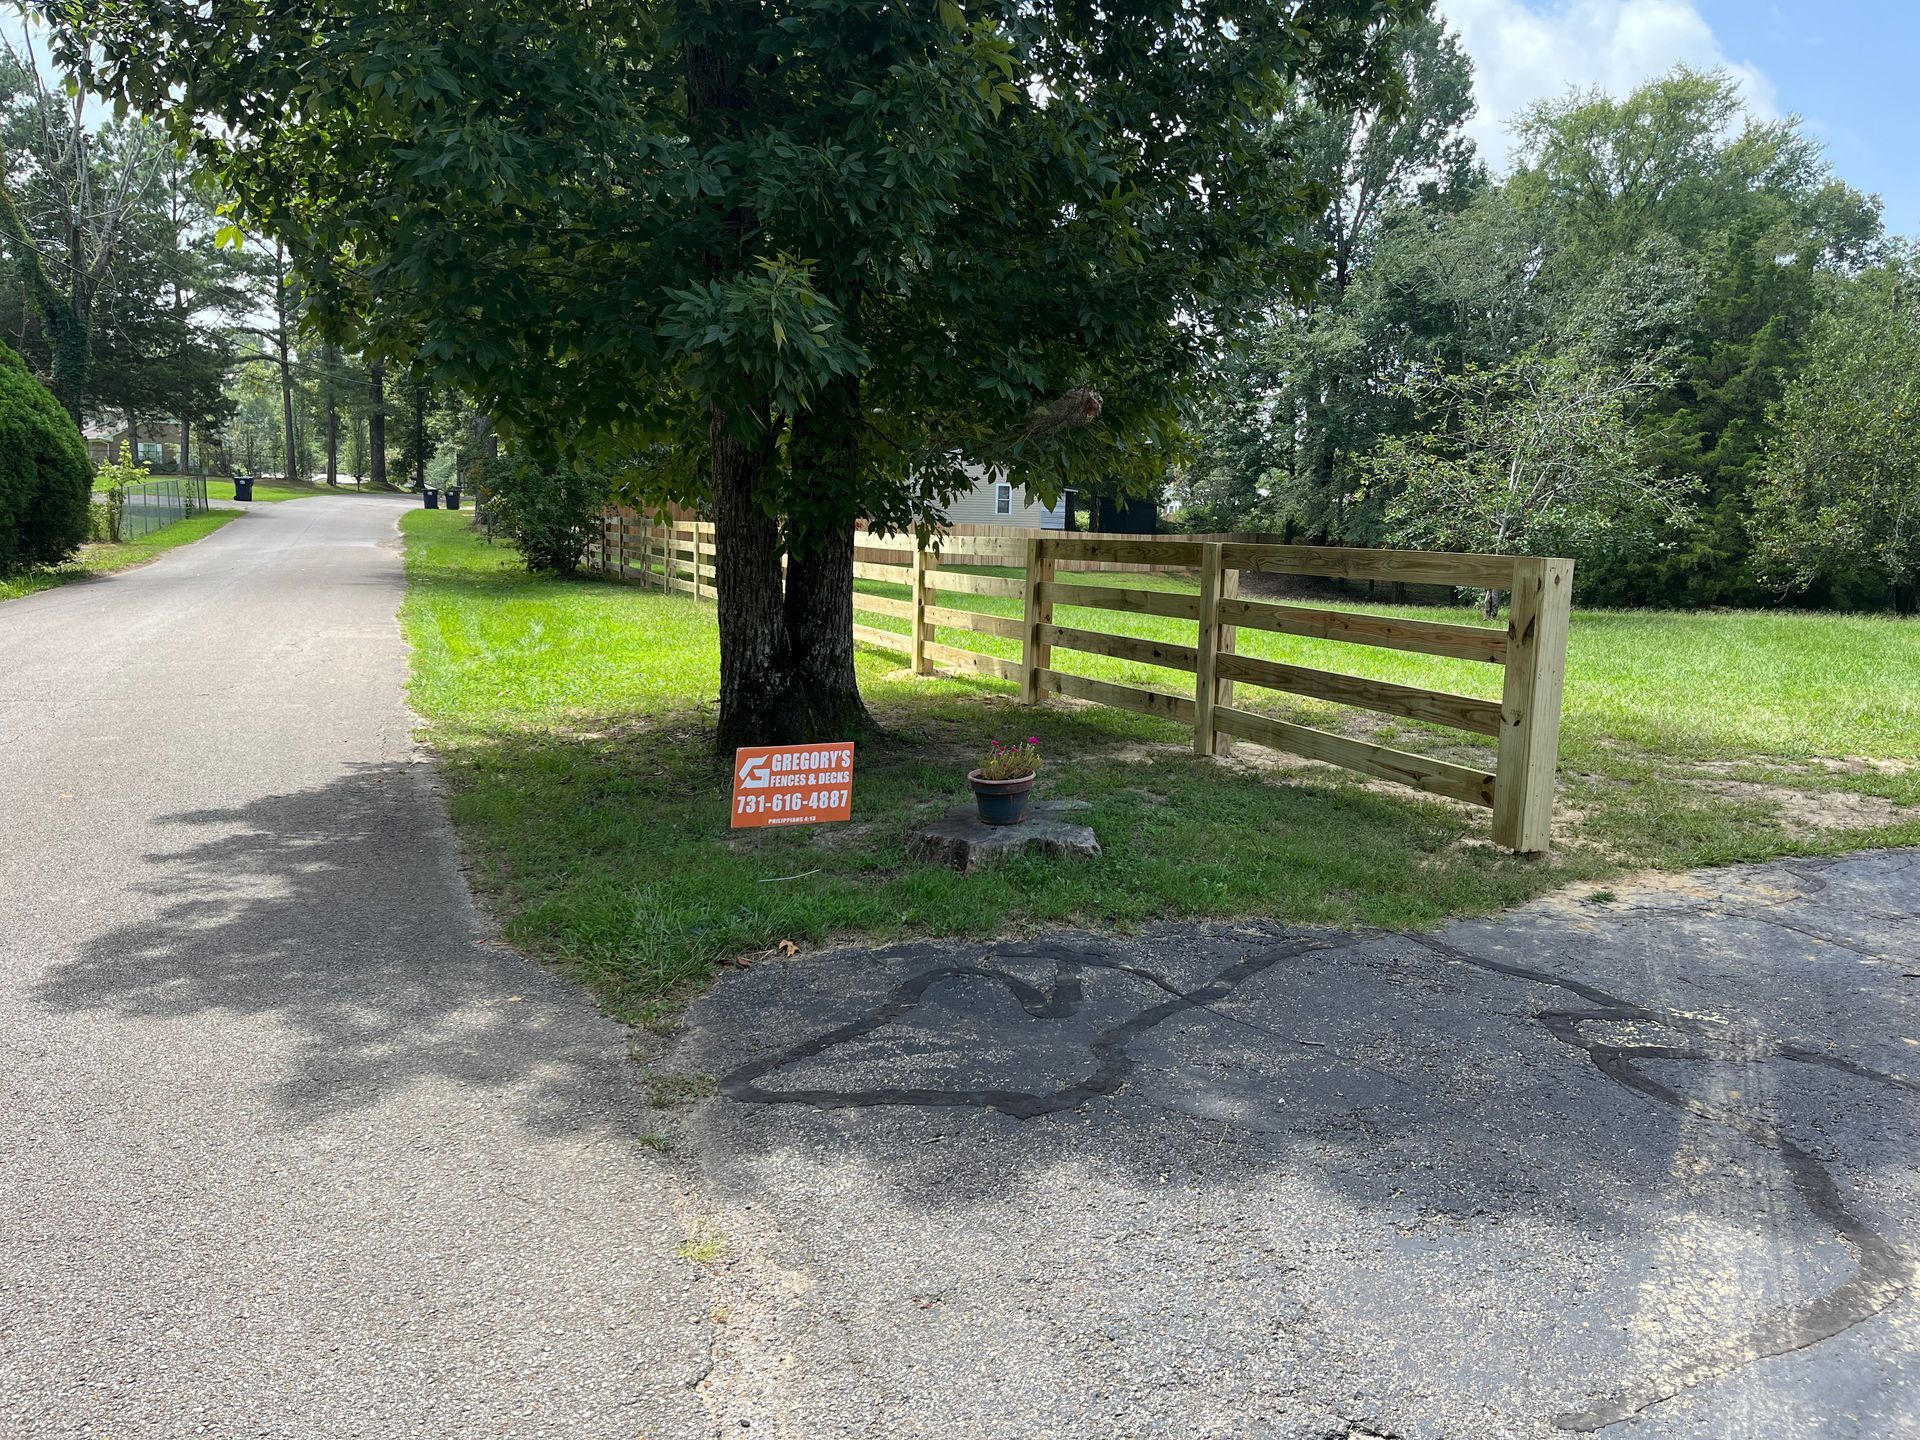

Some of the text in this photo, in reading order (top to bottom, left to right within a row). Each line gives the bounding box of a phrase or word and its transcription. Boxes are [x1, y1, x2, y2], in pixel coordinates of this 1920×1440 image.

[771, 750, 851, 771] GREGORY'S
[770, 771, 850, 787] FENCES & DECKS
[737, 790, 848, 814] 731-616-4887
